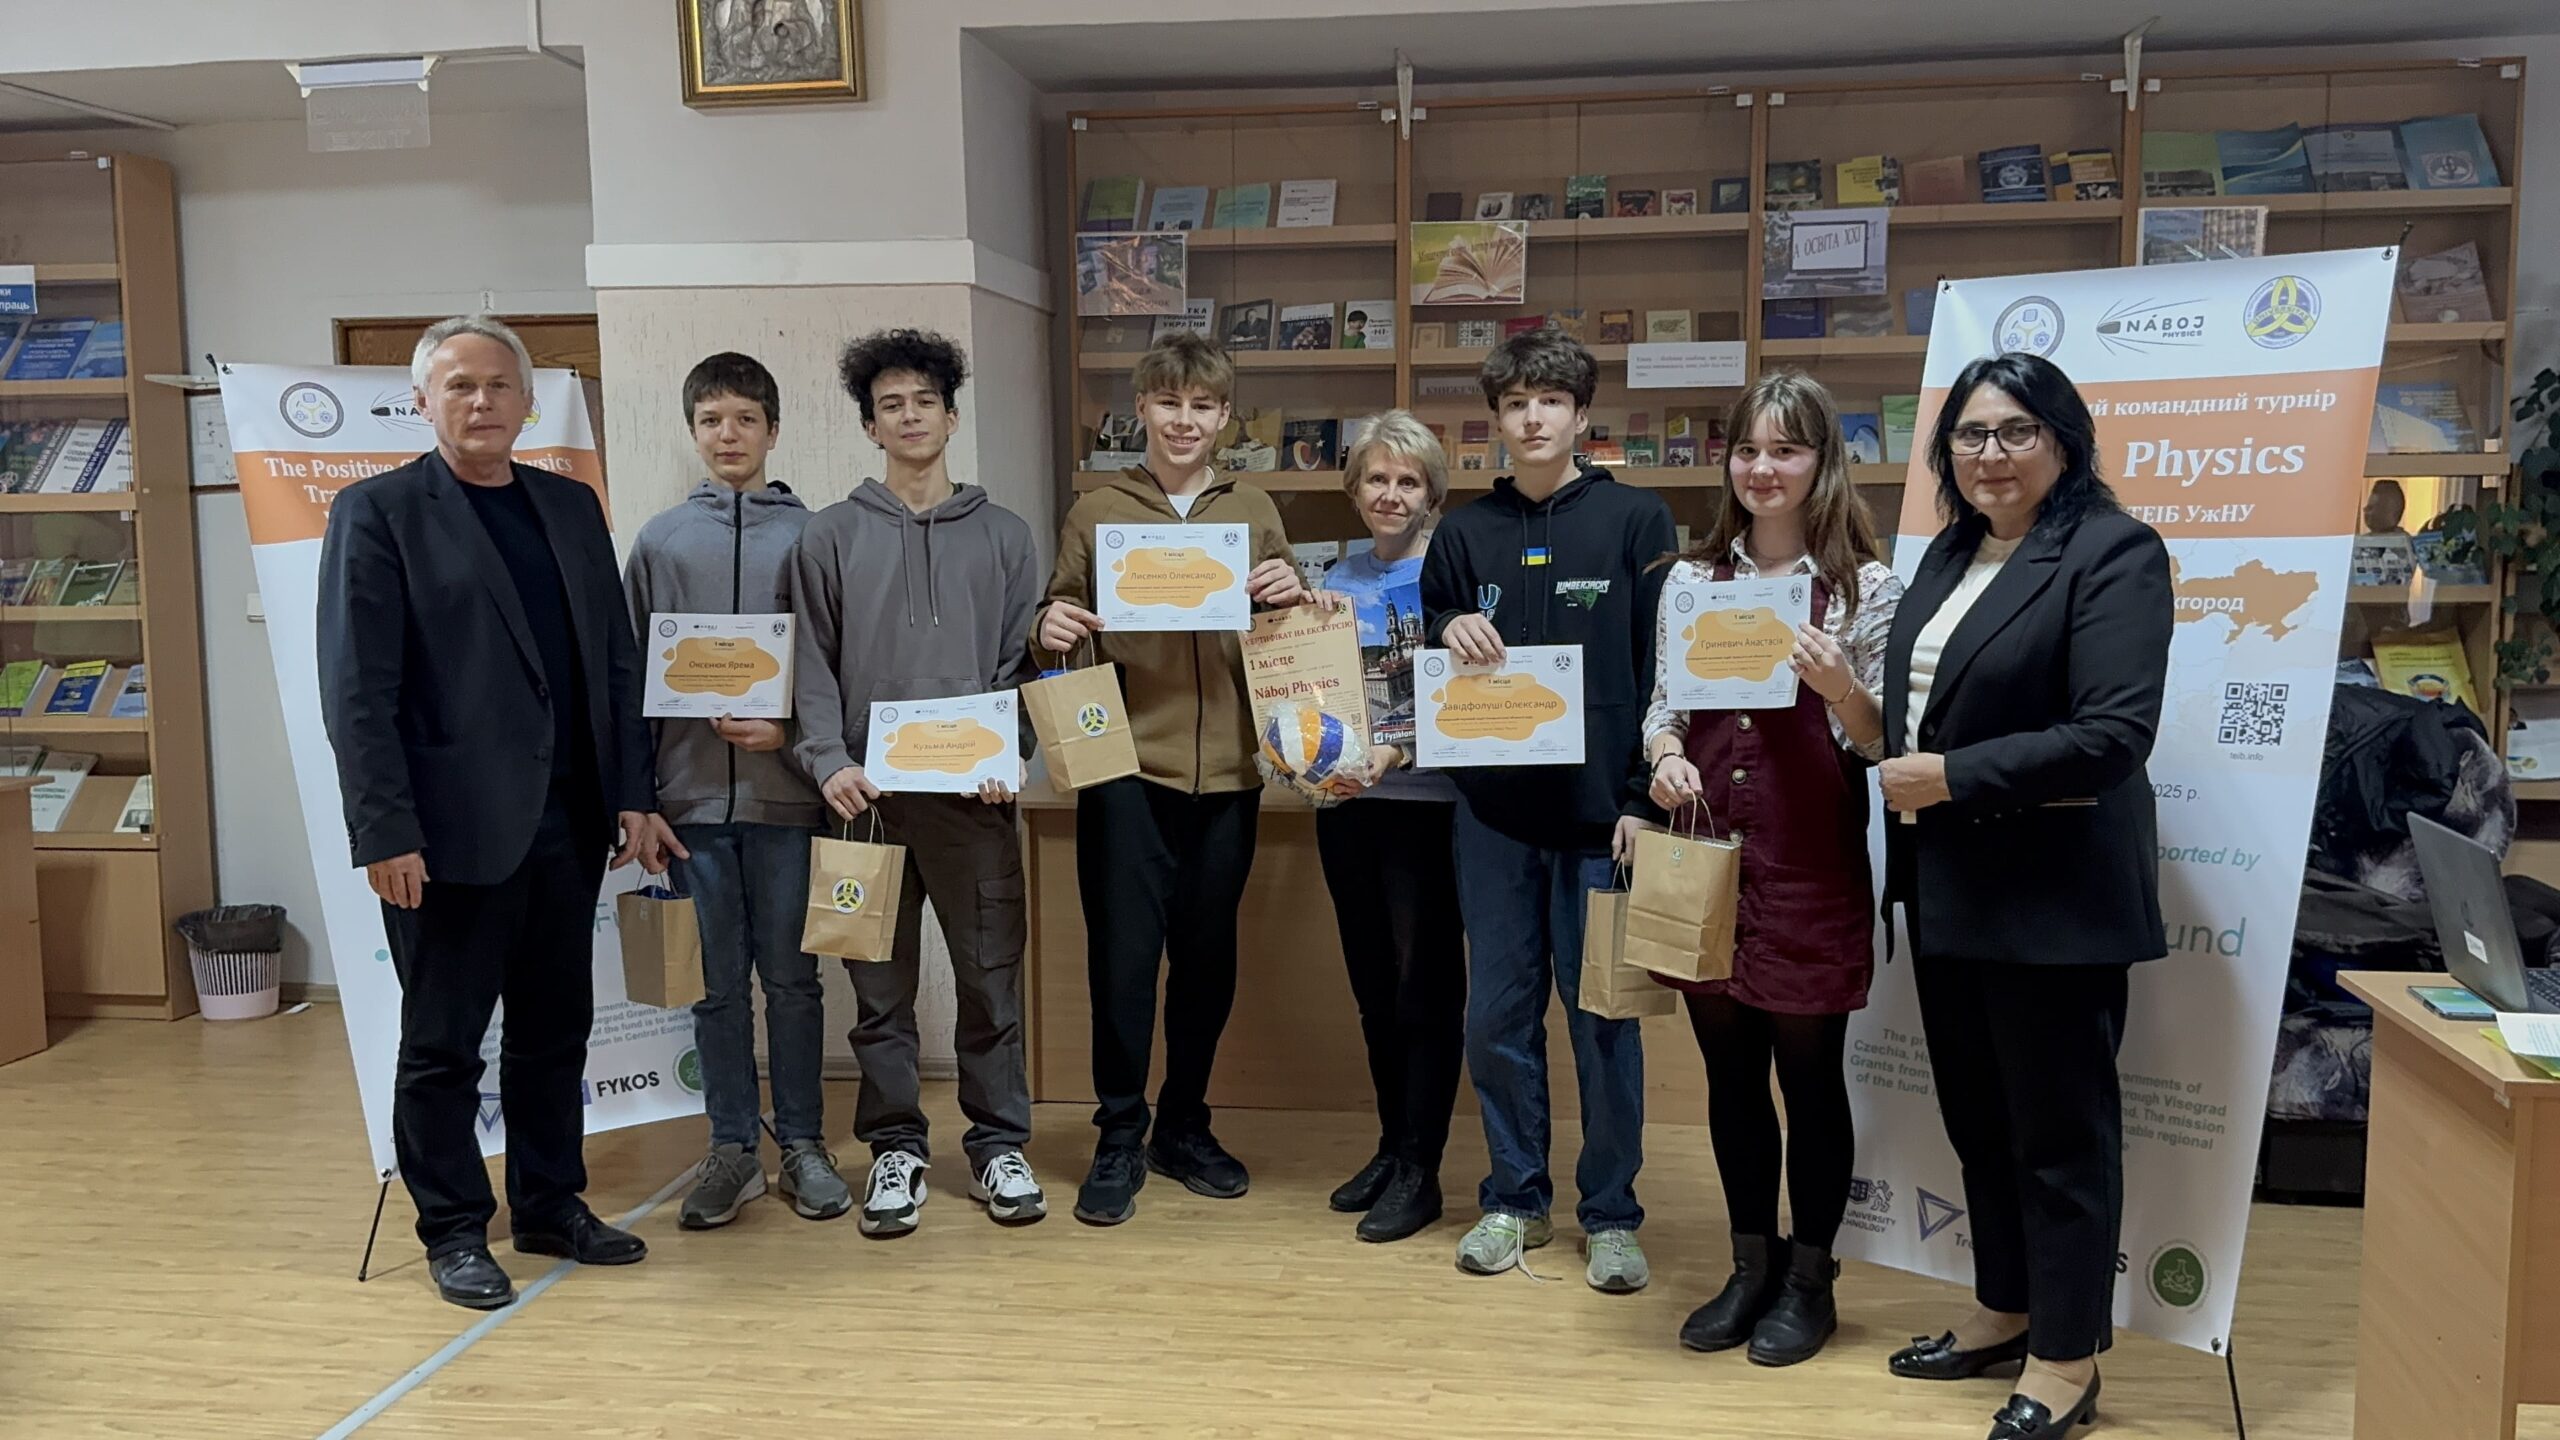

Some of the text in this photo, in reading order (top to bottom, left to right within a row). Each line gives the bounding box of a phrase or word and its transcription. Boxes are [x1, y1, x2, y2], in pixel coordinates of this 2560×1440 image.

[1804, 232, 1840, 257] ОСВІТА
[2126, 314, 2205, 333] NÁBOJ
[2162, 330, 2203, 338] PHYSICS
[2114, 392, 2248, 416] командний
[2254, 388, 2336, 414] турнір
[264, 457, 308, 477] The
[310, 459, 393, 478] Positive
[2122, 437, 2305, 487] Physics
[2185, 503, 2256, 523] УжНУ
[1130, 572, 1217, 582] Лисенко Олександр
[1555, 580, 1610, 594] LUMBERJACKS
[2174, 597, 2244, 613] город
[1245, 631, 1293, 646] СЕРТИФІКАТ
[1307, 621, 1354, 635] ЕКСКУРСІЮ
[1701, 638, 1784, 650] Гриневич Анастасія
[1249, 655, 1295, 670] 1 місце
[1255, 677, 1340, 700] Náboj Physics
[1505, 700, 1557, 711] Олександр
[2153, 783, 2183, 799] 025
[2157, 846, 2261, 872] ported by
[2163, 916, 2247, 957] und
[626, 1008, 658, 1018] Grants
[614, 1035, 623, 1043] in
[625, 1028, 658, 1041] Central
[661, 1022, 693, 1034] Europe
[621, 1020, 643, 1031] fund
[1883, 1028, 1906, 1043] The
[1854, 1040, 1910, 1060] Czechia,
[1850, 1055, 1895, 1073] Grants
[1899, 1063, 1931, 1079] from
[596, 1071, 660, 1097] FYKOS
[1856, 1072, 1929, 1095] of the fund
[2187, 1082, 2203, 1095] of
[2164, 1094, 2227, 1117] Visegrad
[2144, 1108, 2165, 1124] The
[2168, 1115, 2226, 1135] mission
[2157, 1131, 2214, 1151] regional
[1842, 1217, 1886, 1233] CHNOLOGY
[1847, 1208, 1896, 1226] UNIVERSITY
